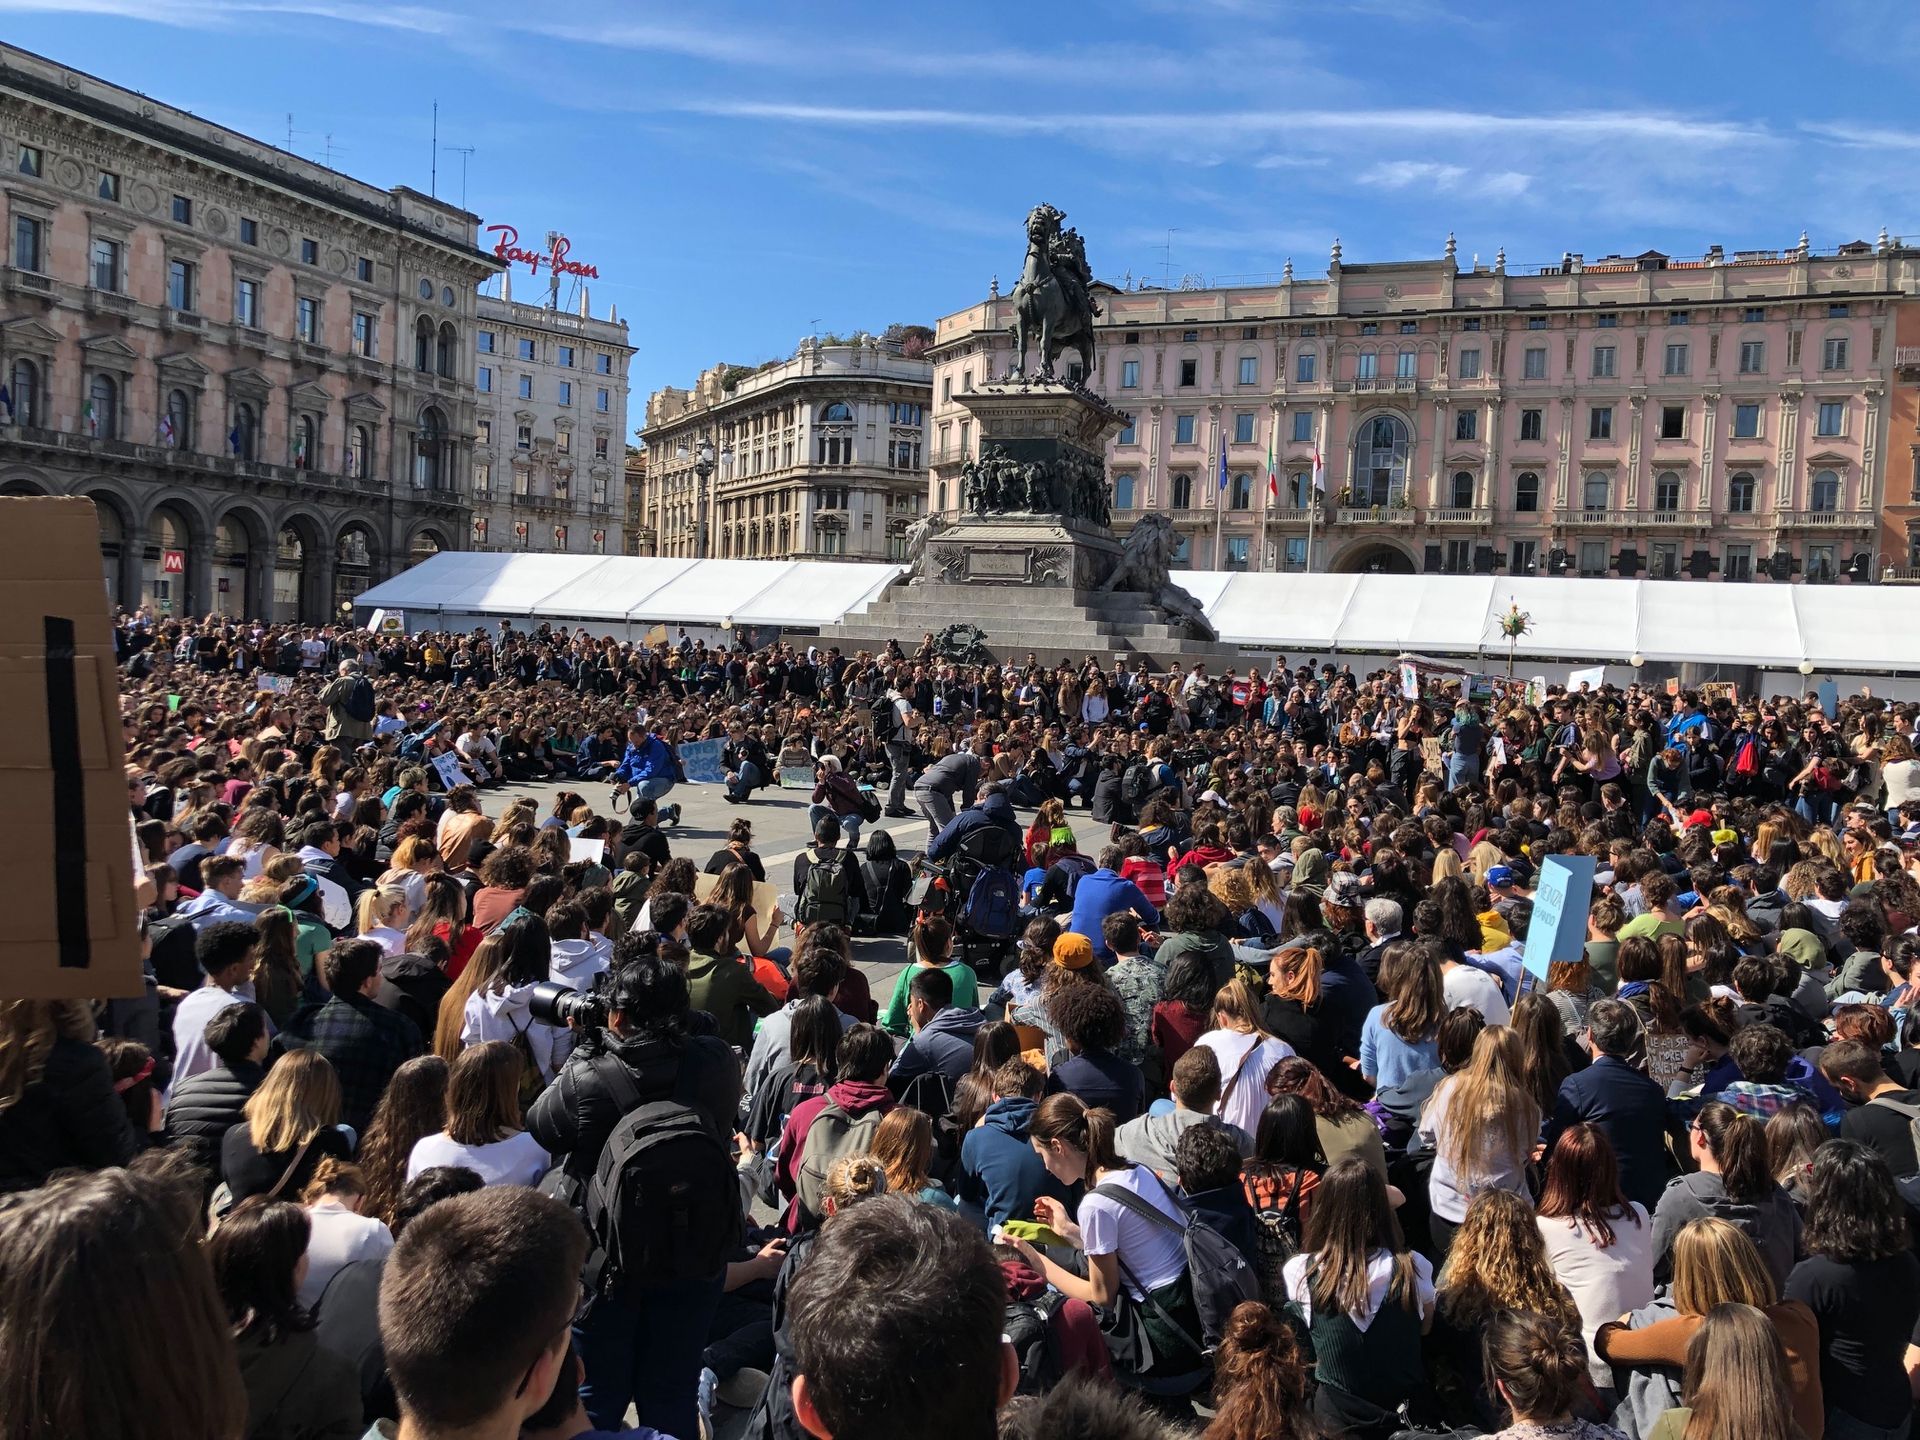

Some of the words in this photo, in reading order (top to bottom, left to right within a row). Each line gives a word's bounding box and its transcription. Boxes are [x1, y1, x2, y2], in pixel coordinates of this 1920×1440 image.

[486, 224, 600, 279] Ray-Ban
[165, 555, 183, 569] M
[1532, 906, 1556, 927] BANDO
